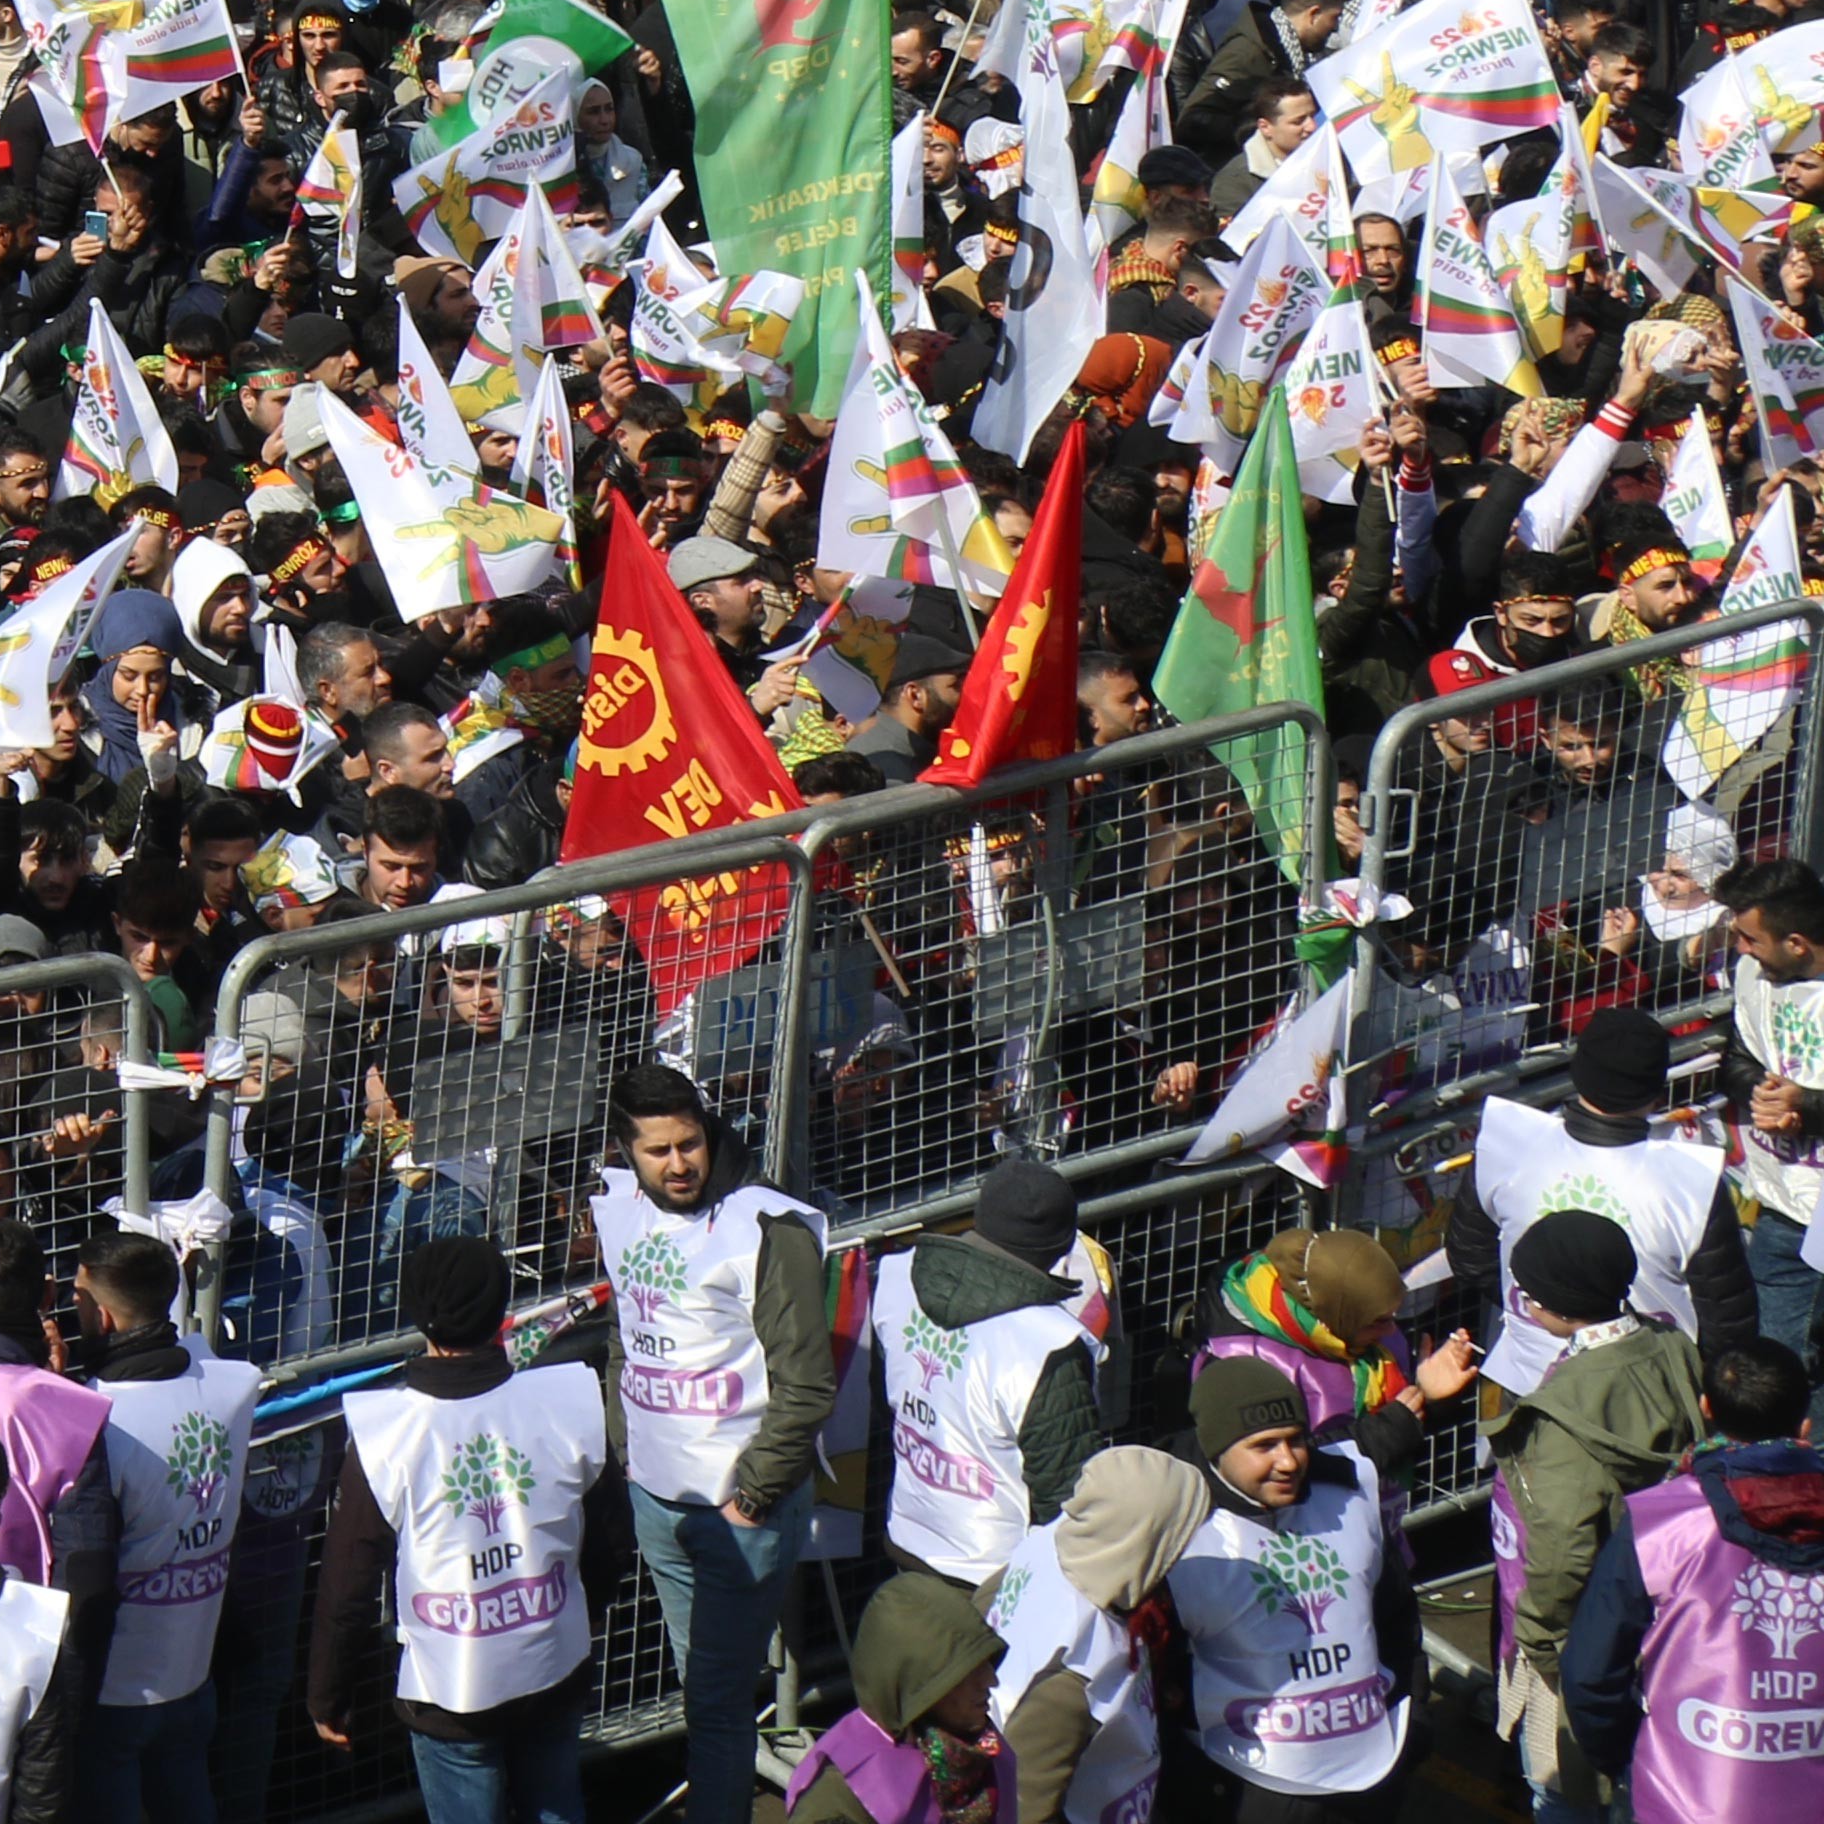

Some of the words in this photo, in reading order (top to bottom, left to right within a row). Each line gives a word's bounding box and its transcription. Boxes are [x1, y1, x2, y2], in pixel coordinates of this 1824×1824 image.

[272, 537, 319, 580] NEWROZ
[631, 1331, 677, 1358] HDP
[902, 1390, 937, 1429] HDP
[1243, 1400, 1292, 1425] COOL
[255, 1482, 297, 1508] HDP
[177, 1518, 221, 1550] HDP
[469, 1542, 523, 1577] HDP
[424, 1565, 565, 1630] GÖREVLİ
[1290, 1643, 1351, 1677] HDP
[1749, 1671, 1816, 1701] HDP
